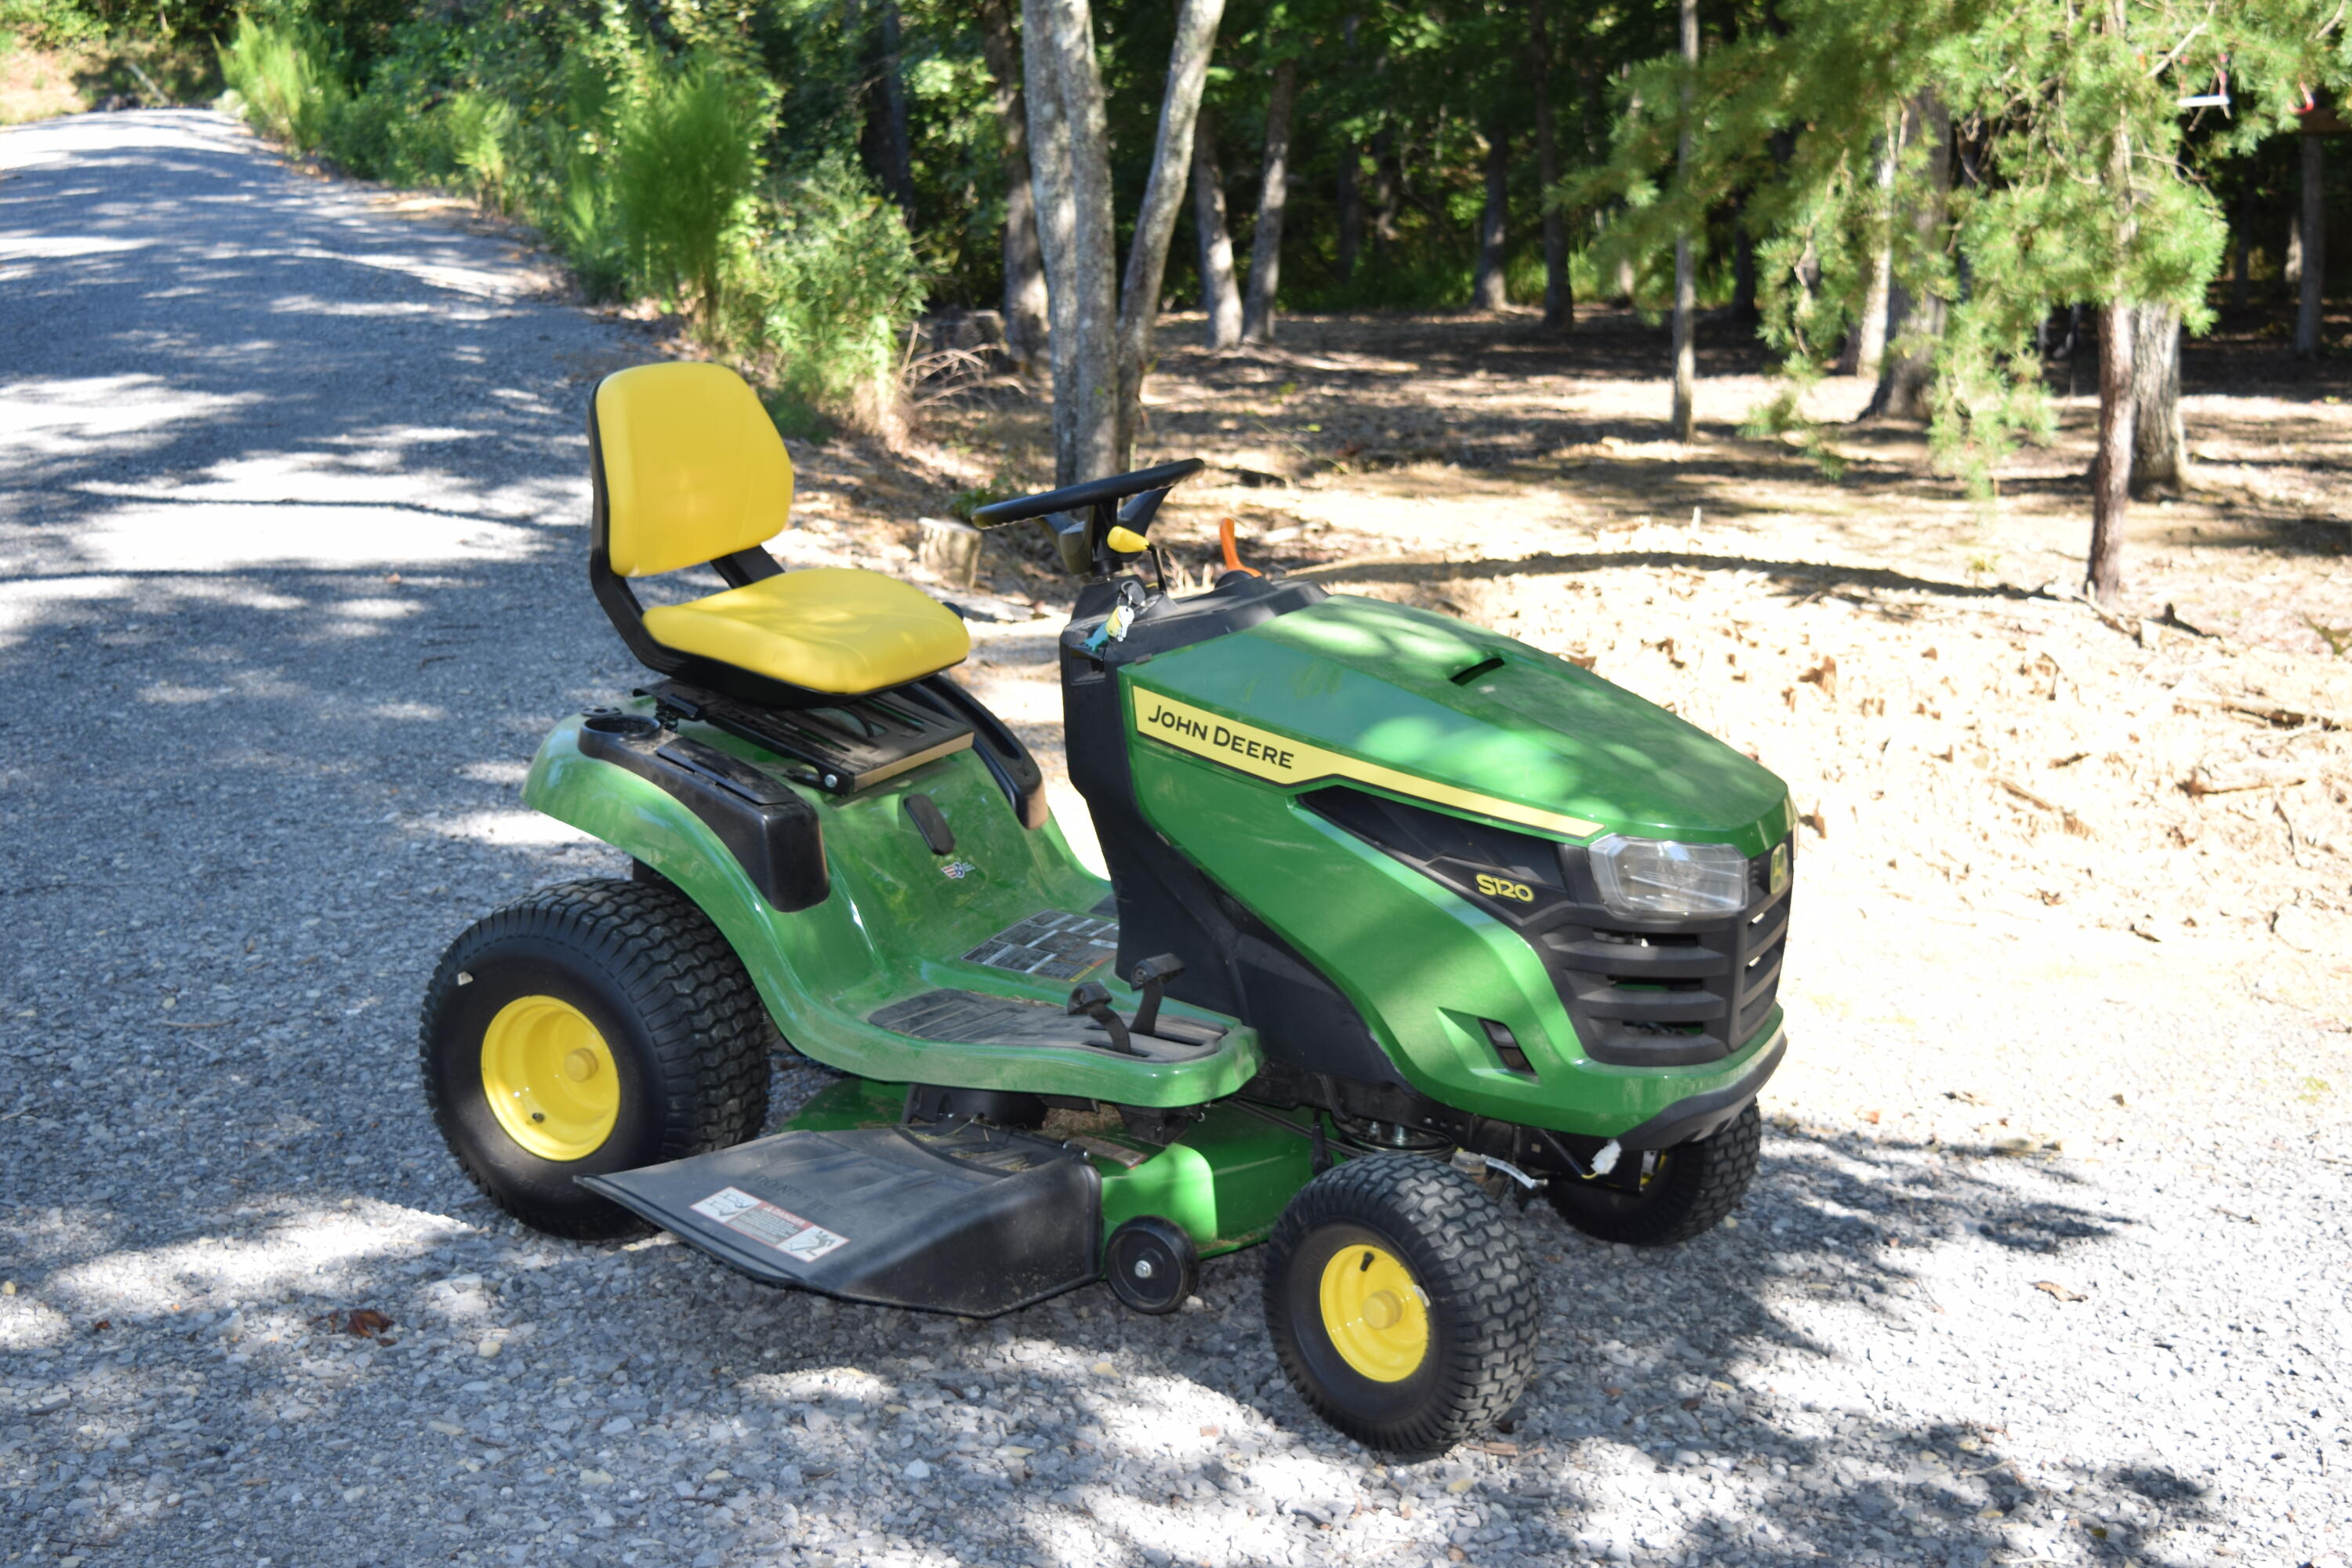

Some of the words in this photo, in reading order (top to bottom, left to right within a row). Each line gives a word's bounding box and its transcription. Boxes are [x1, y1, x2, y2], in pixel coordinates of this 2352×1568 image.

[1148, 705, 1208, 741] JOHN
[1213, 726, 1294, 769] DEERE
[1475, 873, 1534, 902] S120
